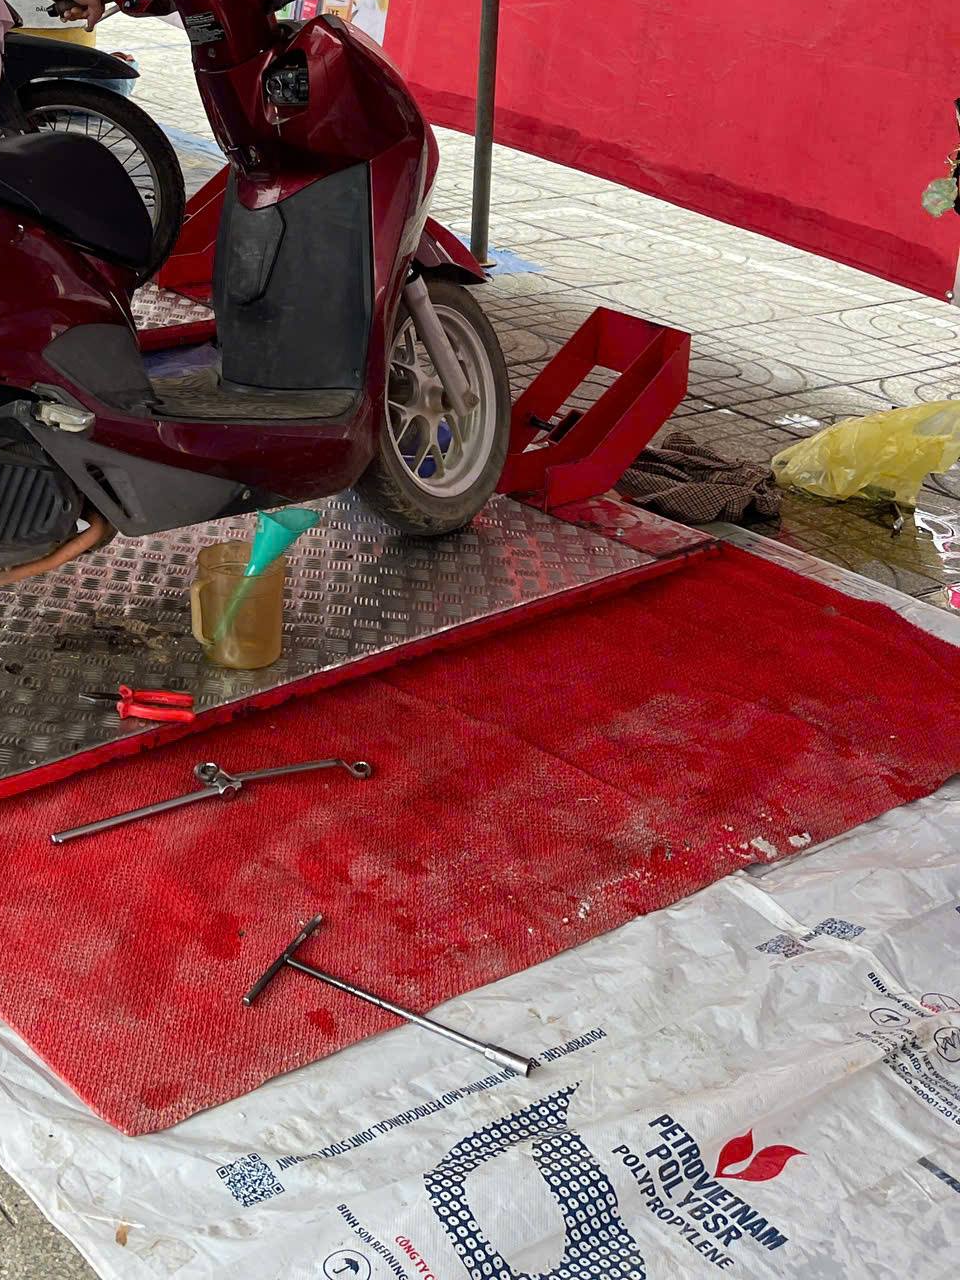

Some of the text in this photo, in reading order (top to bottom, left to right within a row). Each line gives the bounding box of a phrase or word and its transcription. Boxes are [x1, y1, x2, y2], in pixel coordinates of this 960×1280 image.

[867, 972, 887, 992] BINH
[542, 1027, 606, 1062] POLYPROPYLENE
[440, 1088, 463, 1106] AND
[373, 1096, 444, 1136] PETROCHEMICAL
[319, 1138, 351, 1161] STOCK
[347, 1126, 377, 1149] JOINT
[648, 1114, 789, 1251] PETROVIETNAM
[611, 1144, 735, 1270] POLYPROPYLENE
[336, 1202, 409, 1280] BINH SON REFINING
[395, 1234, 420, 1261] CÔNG
[414, 1258, 429, 1275] TY
